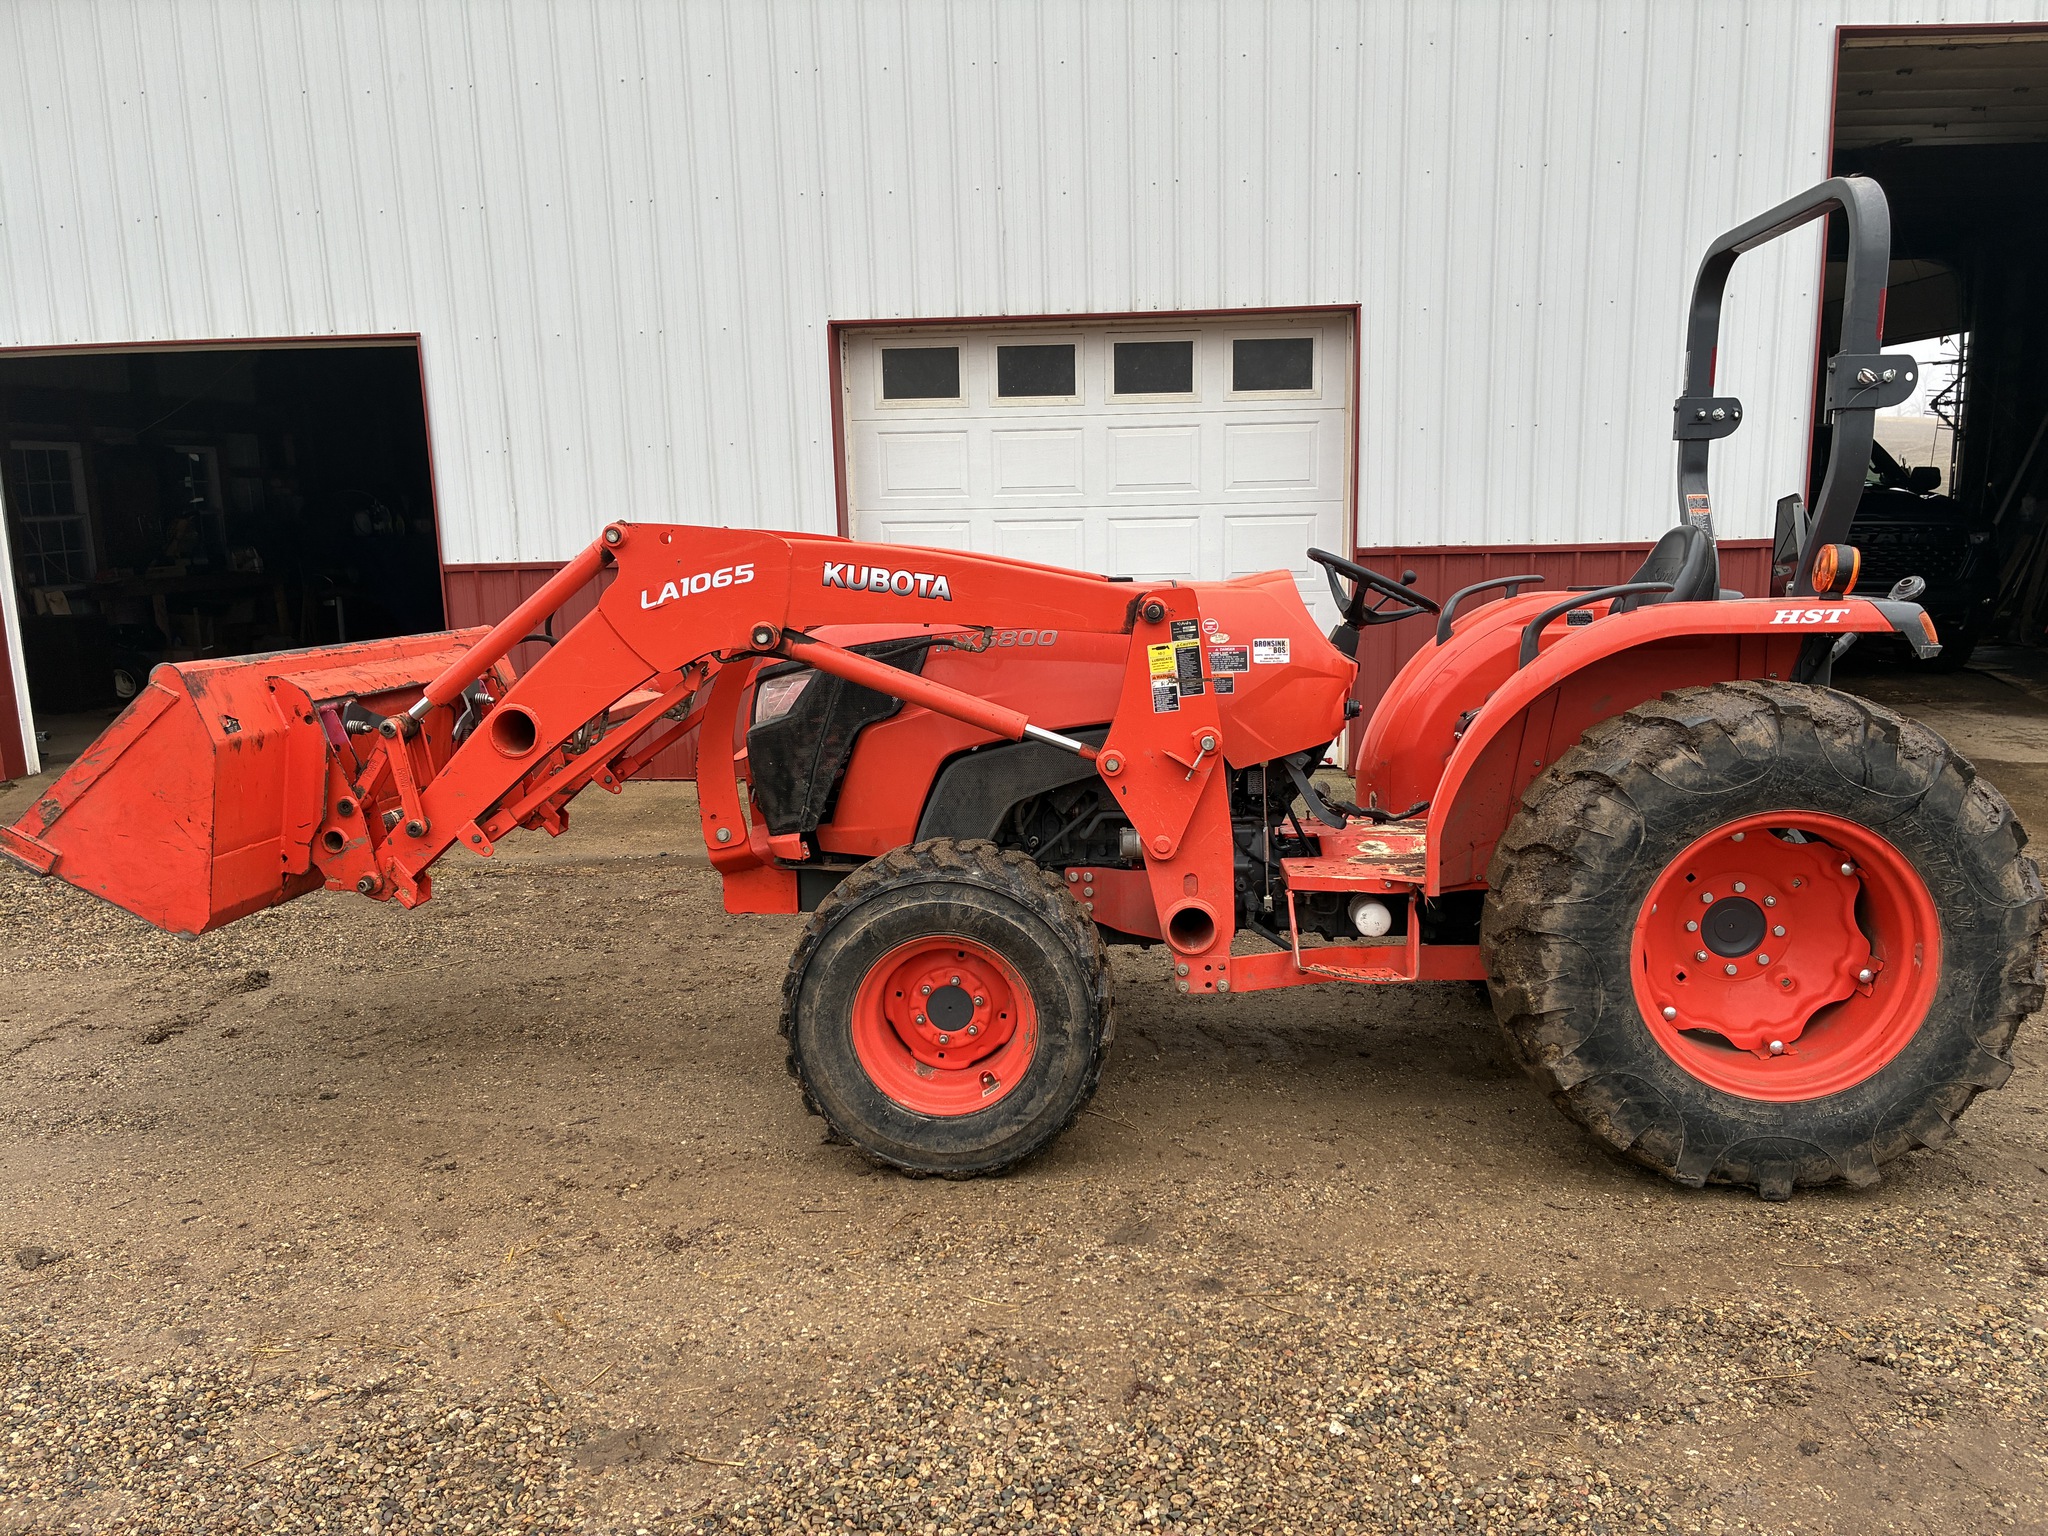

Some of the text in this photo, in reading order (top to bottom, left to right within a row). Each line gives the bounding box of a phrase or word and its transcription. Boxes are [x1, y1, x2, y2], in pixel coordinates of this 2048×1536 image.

[640, 562, 755, 610] LA1065
[822, 561, 953, 601] KUBOTA
[1769, 608, 1850, 626] HST
[1254, 640, 1286, 648] BRONSINK
[1892, 816, 1976, 928] TITAN
[867, 883, 949, 915] 2000
